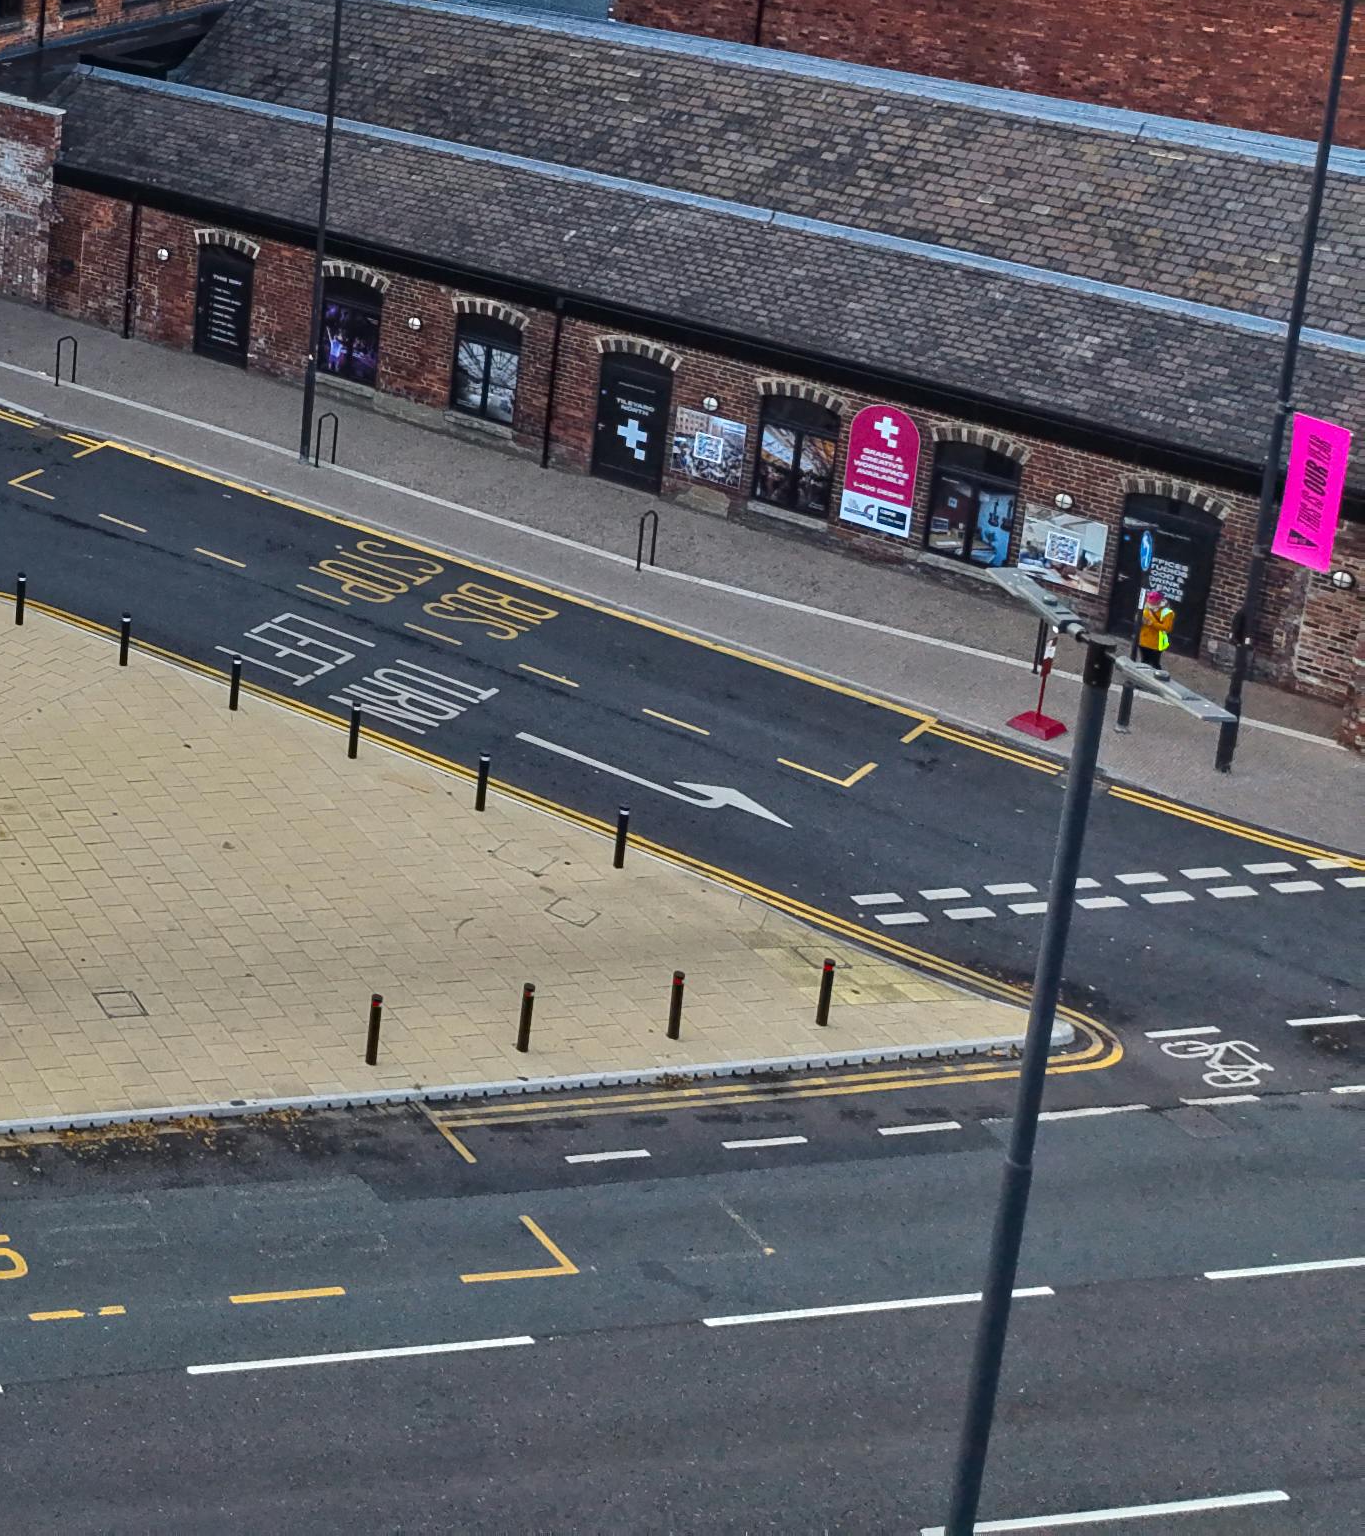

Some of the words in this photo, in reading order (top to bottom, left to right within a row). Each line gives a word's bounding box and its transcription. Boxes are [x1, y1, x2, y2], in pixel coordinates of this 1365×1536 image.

[615, 396, 656, 413] TILEYARD
[620, 404, 650, 417] NORTH
[860, 454, 904, 471] CREATIVE
[862, 447, 895, 461] GRADE
[1307, 434, 1333, 466] YEAR
[853, 459, 910, 480] WORKSPACE
[856, 467, 905, 486] AVAILABLE
[1303, 458, 1330, 497] OUR
[1297, 502, 1322, 534] THIS
[309, 540, 445, 603] STOP
[1152, 557, 1189, 572] FFICES
[422, 582, 559, 640] BUS
[214, 612, 376, 687] LEFT
[327, 658, 501, 735] TURN
